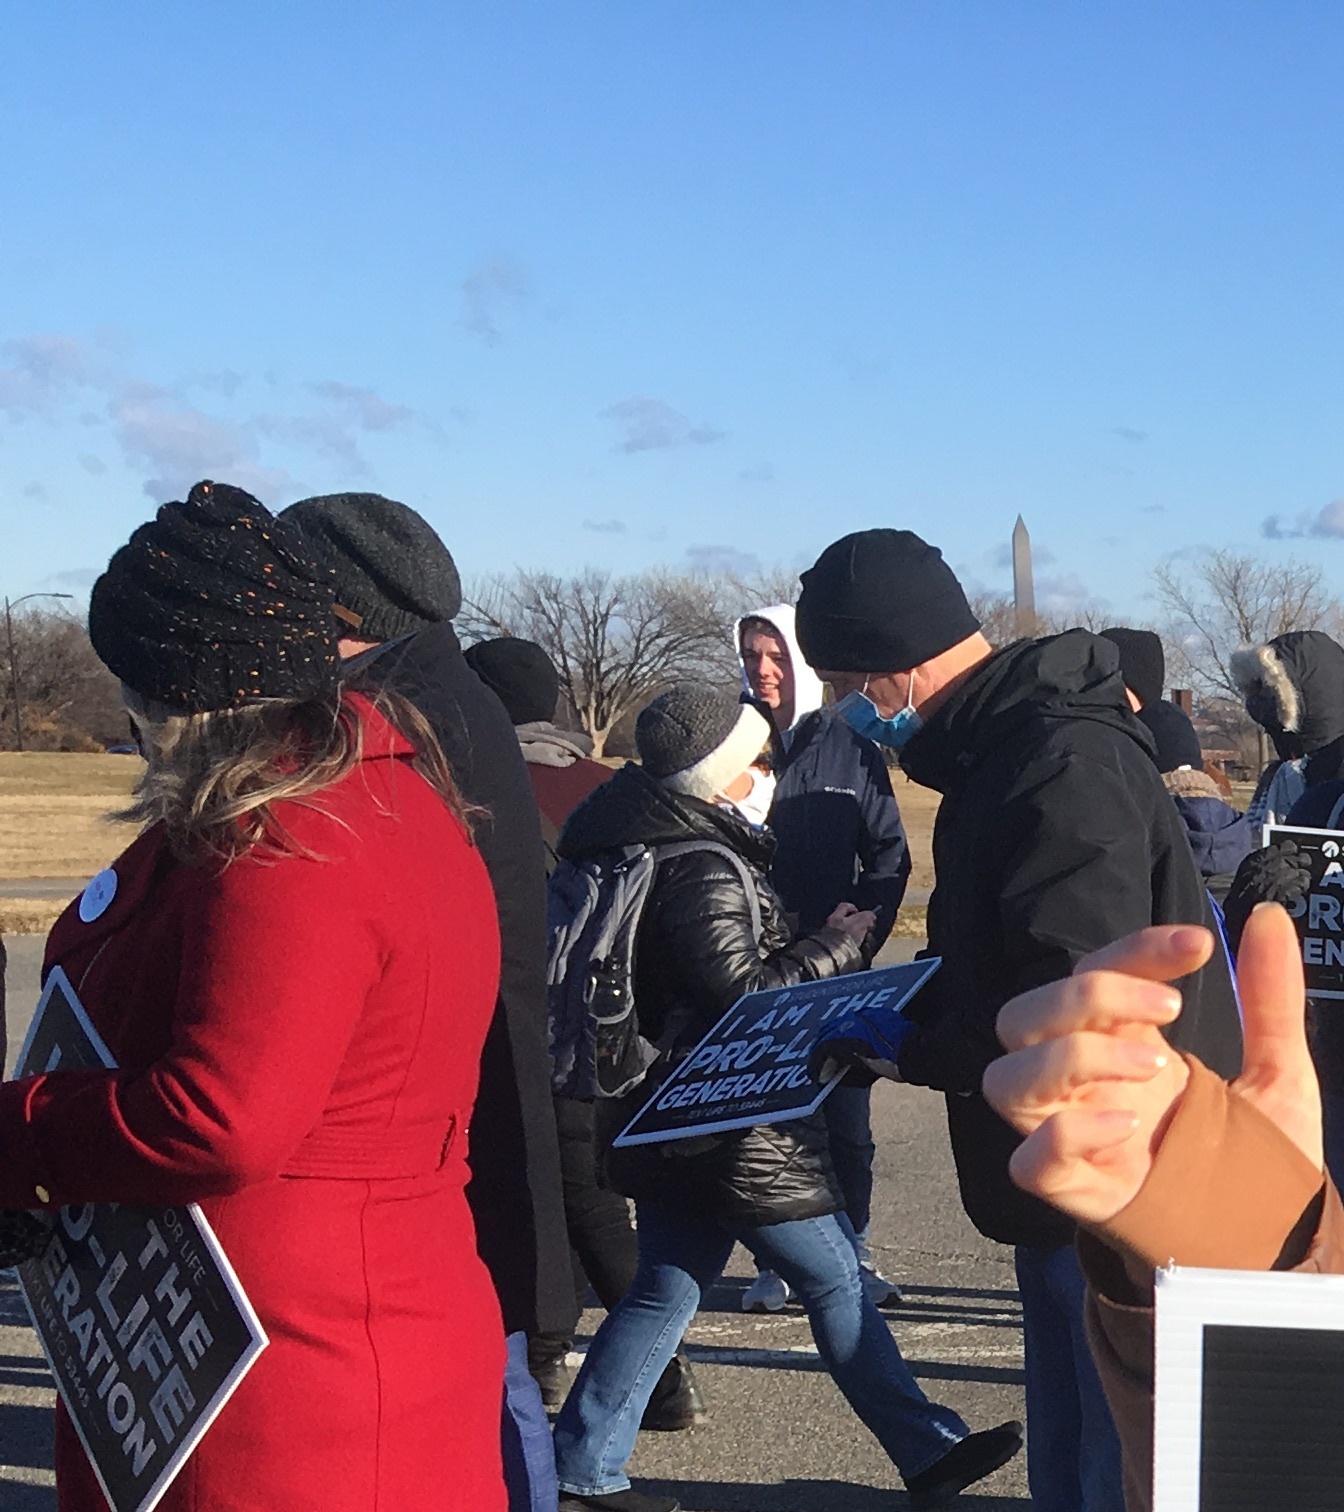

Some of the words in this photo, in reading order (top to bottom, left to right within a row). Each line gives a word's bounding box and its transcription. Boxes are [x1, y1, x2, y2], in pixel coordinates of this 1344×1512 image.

[721, 1014, 744, 1039] I
[746, 1002, 815, 1034] AM
[820, 986, 898, 1020] THE
[656, 1064, 813, 1111] GENERATIO
[678, 1028, 818, 1080] PRO-LI
[163, 1207, 185, 1244] OR
[179, 1242, 207, 1287] LIFE
[59, 1202, 197, 1445] O-LIFE
[137, 1218, 215, 1371] THE
[41, 1233, 157, 1479] ERATION
